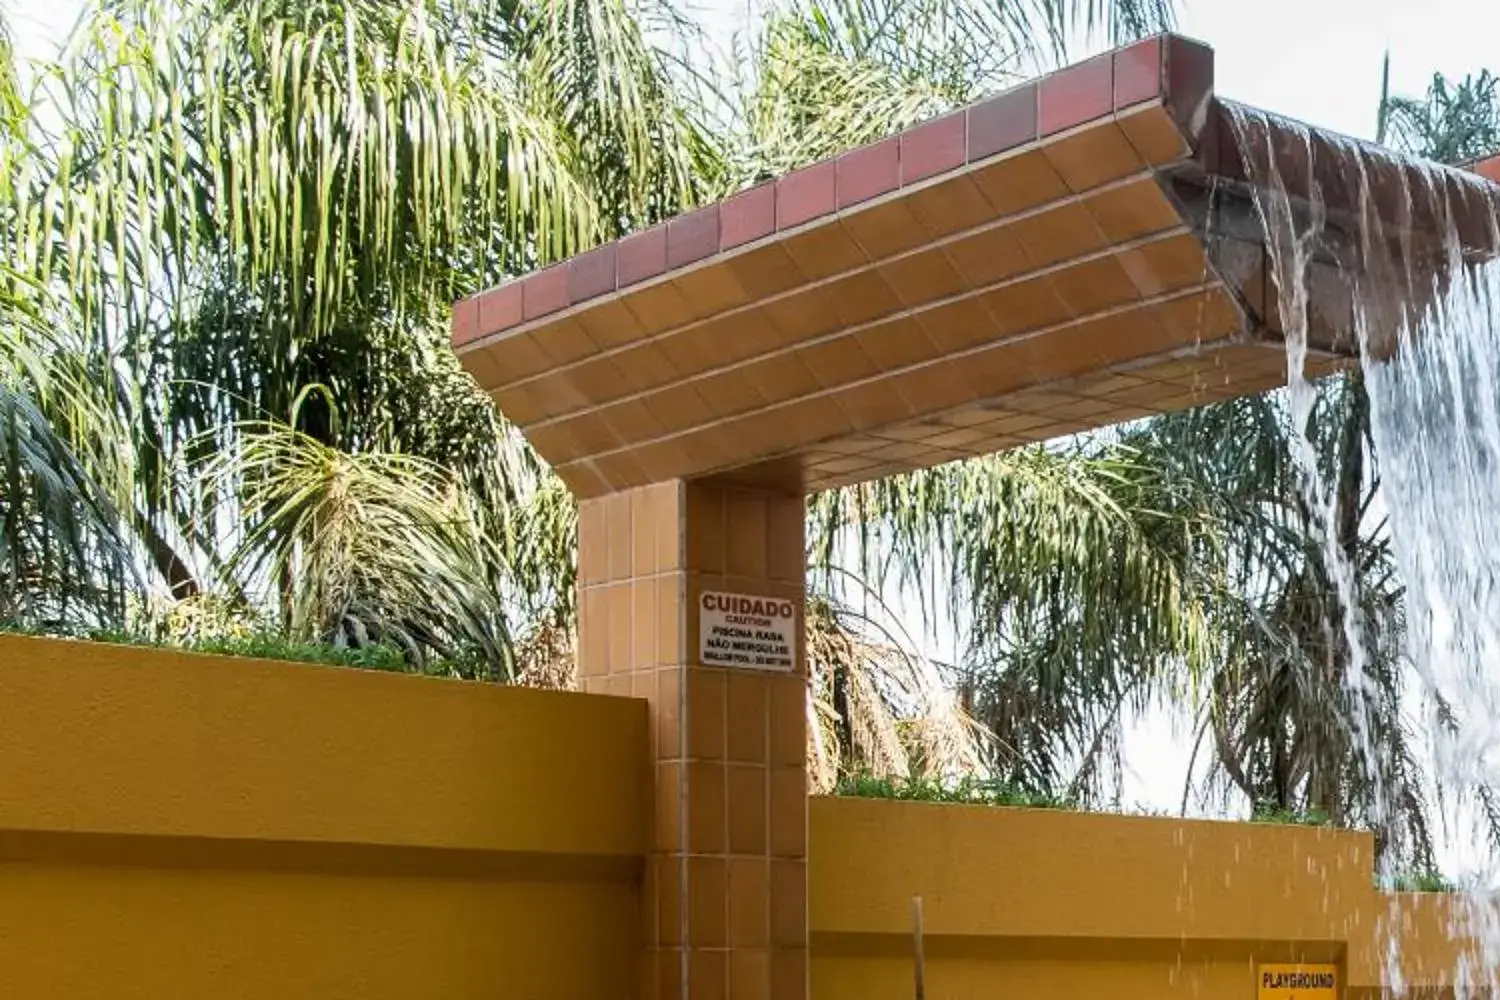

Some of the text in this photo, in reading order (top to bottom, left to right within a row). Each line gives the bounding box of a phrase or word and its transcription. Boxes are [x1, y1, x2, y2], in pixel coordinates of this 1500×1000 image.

[702, 594, 792, 619] CUIDADO
[725, 615, 771, 627] CAUTION
[712, 626, 752, 638] PISCINA
[707, 638, 730, 649] NÃO
[1263, 972, 1334, 989] PLAYGROUND
